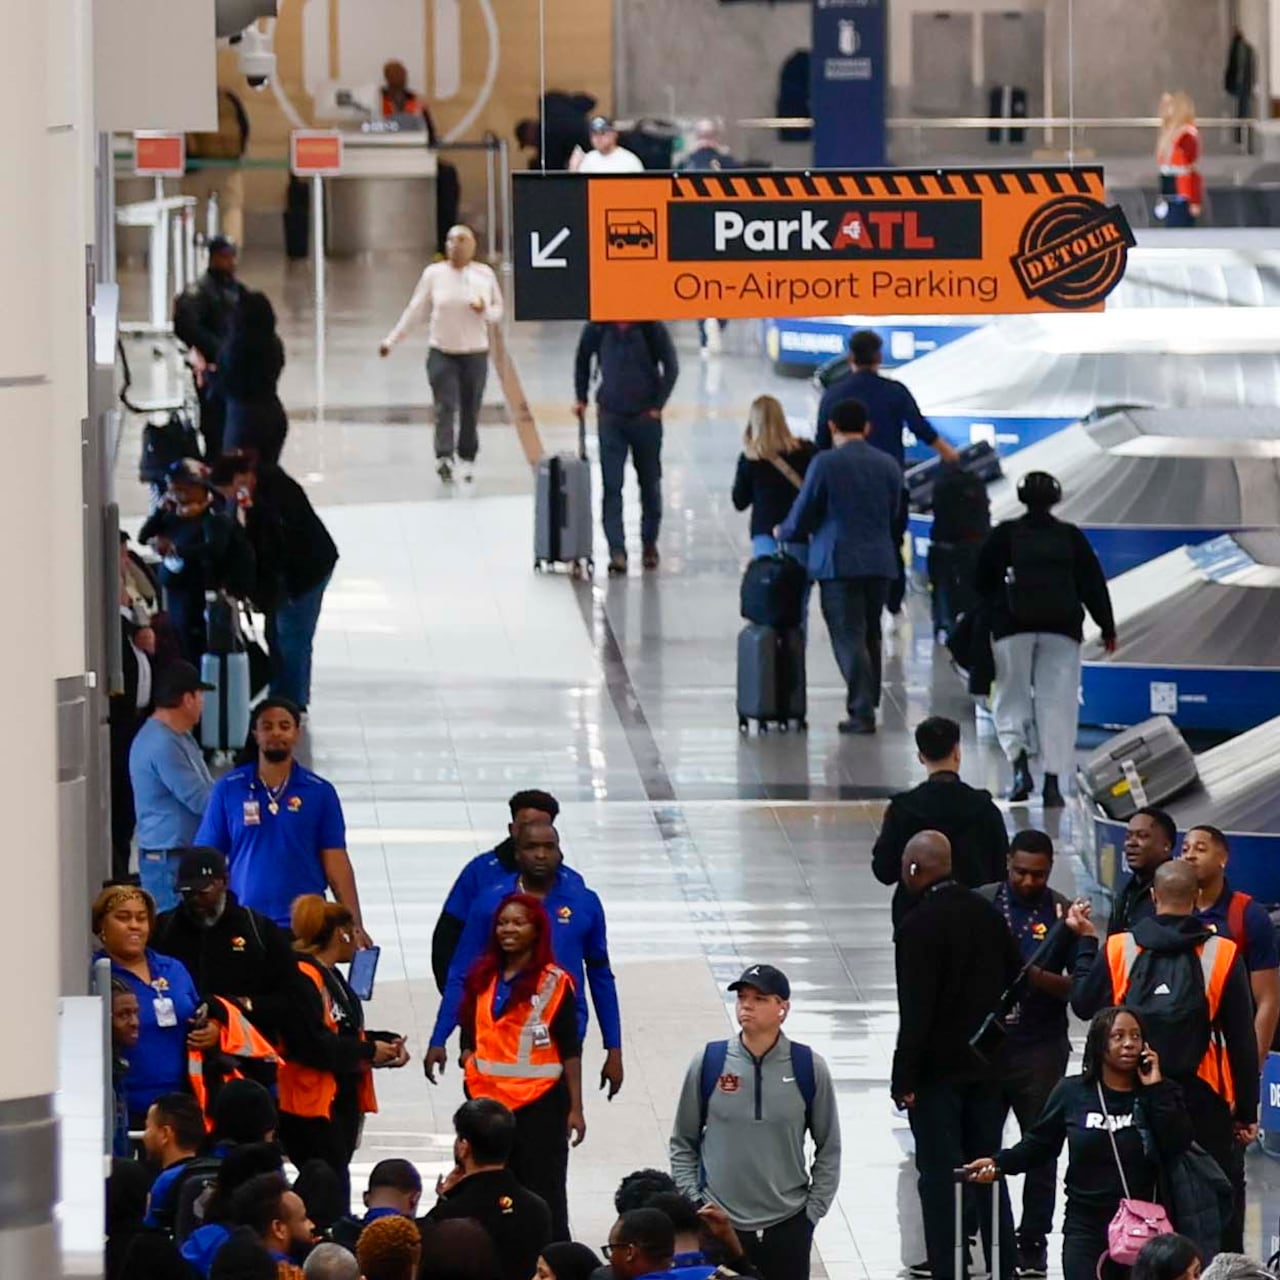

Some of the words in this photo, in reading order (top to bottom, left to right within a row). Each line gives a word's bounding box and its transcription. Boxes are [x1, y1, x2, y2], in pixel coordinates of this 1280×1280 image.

[1026, 221, 1122, 280] DETOUR
[674, 270, 859, 304] On-Airport
[872, 270, 999, 302] Parking
